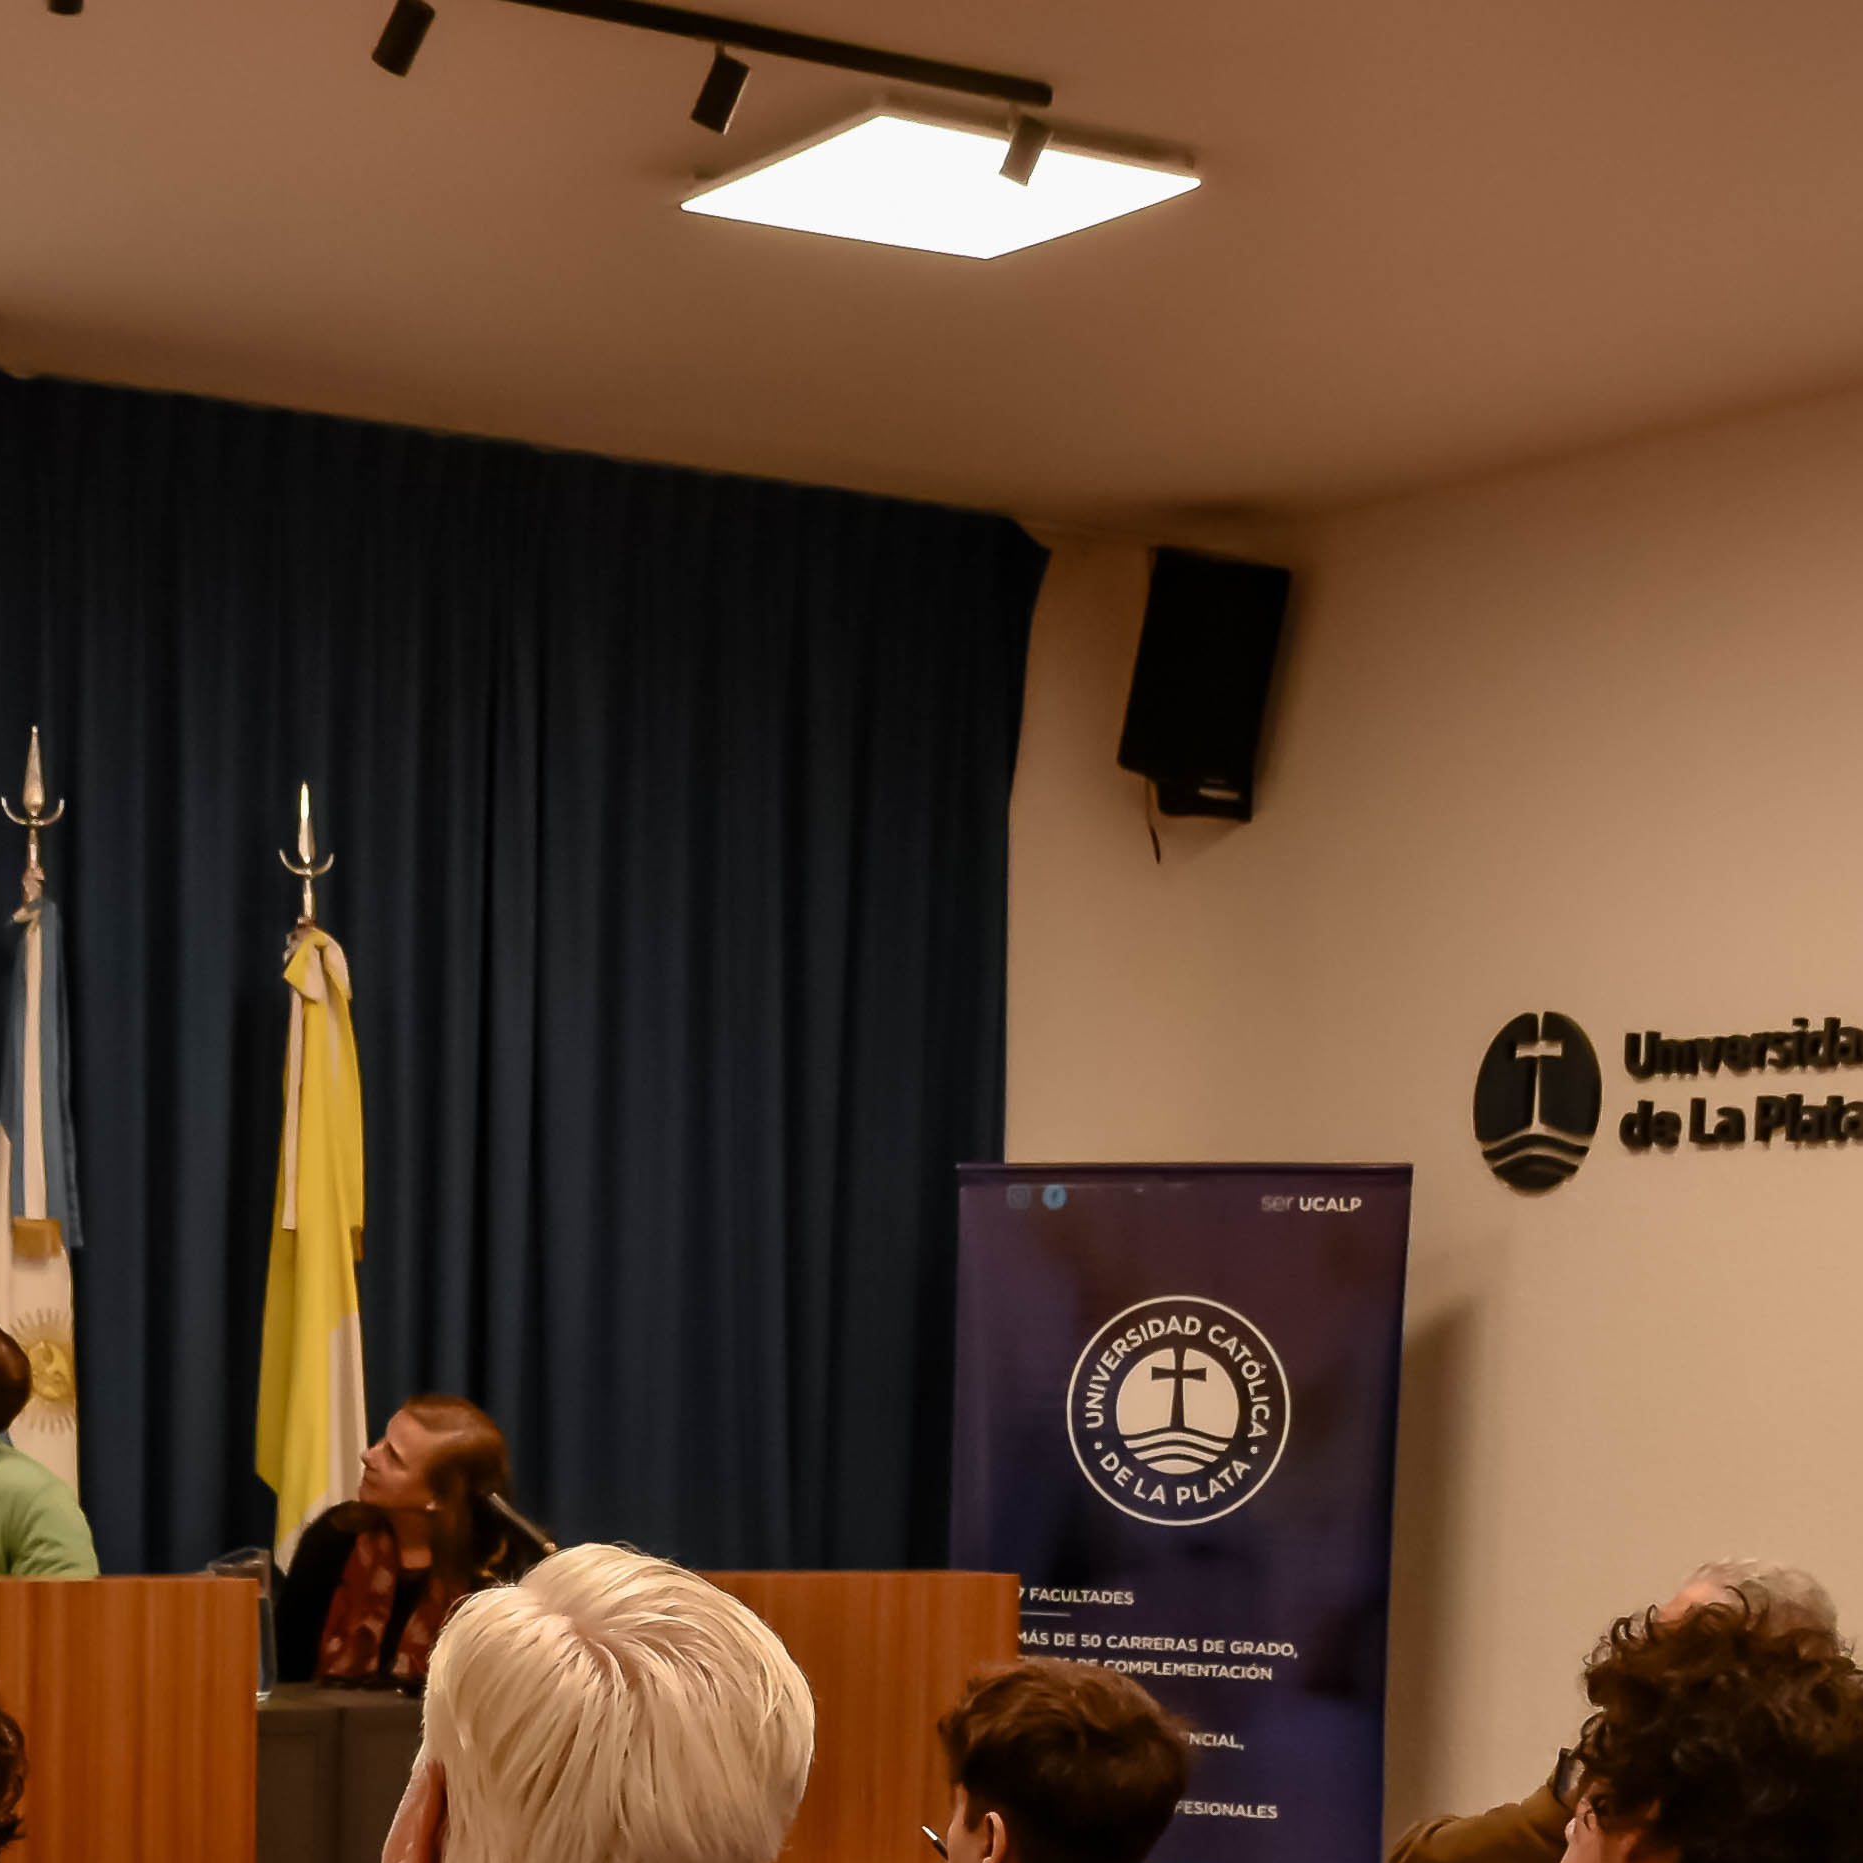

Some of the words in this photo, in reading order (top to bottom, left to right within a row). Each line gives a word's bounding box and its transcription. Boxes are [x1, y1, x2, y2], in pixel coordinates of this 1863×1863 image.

[1619, 1100, 1682, 1150] de
[1689, 1098, 1746, 1144] La
[1299, 1196, 1362, 1212] UCALP
[1085, 1315, 1202, 1430] UNIVERSIDAD
[1207, 1324, 1271, 1440] CATÓLICA
[1100, 1450, 1135, 1487] DE
[1133, 1478, 1167, 1504] LA
[1177, 1458, 1252, 1506] PLATA
[1030, 1588, 1135, 1605] FACULTADES
[1054, 1632, 1076, 1647] DE
[1081, 1634, 1101, 1648] 50
[1106, 1635, 1198, 1653] CARRERAS
[1202, 1639, 1225, 1654] DE
[1230, 1640, 1299, 1660] GRADO,
[1185, 1731, 1244, 1751] NCIAL,
[1175, 1800, 1279, 1820] FESIONALES
